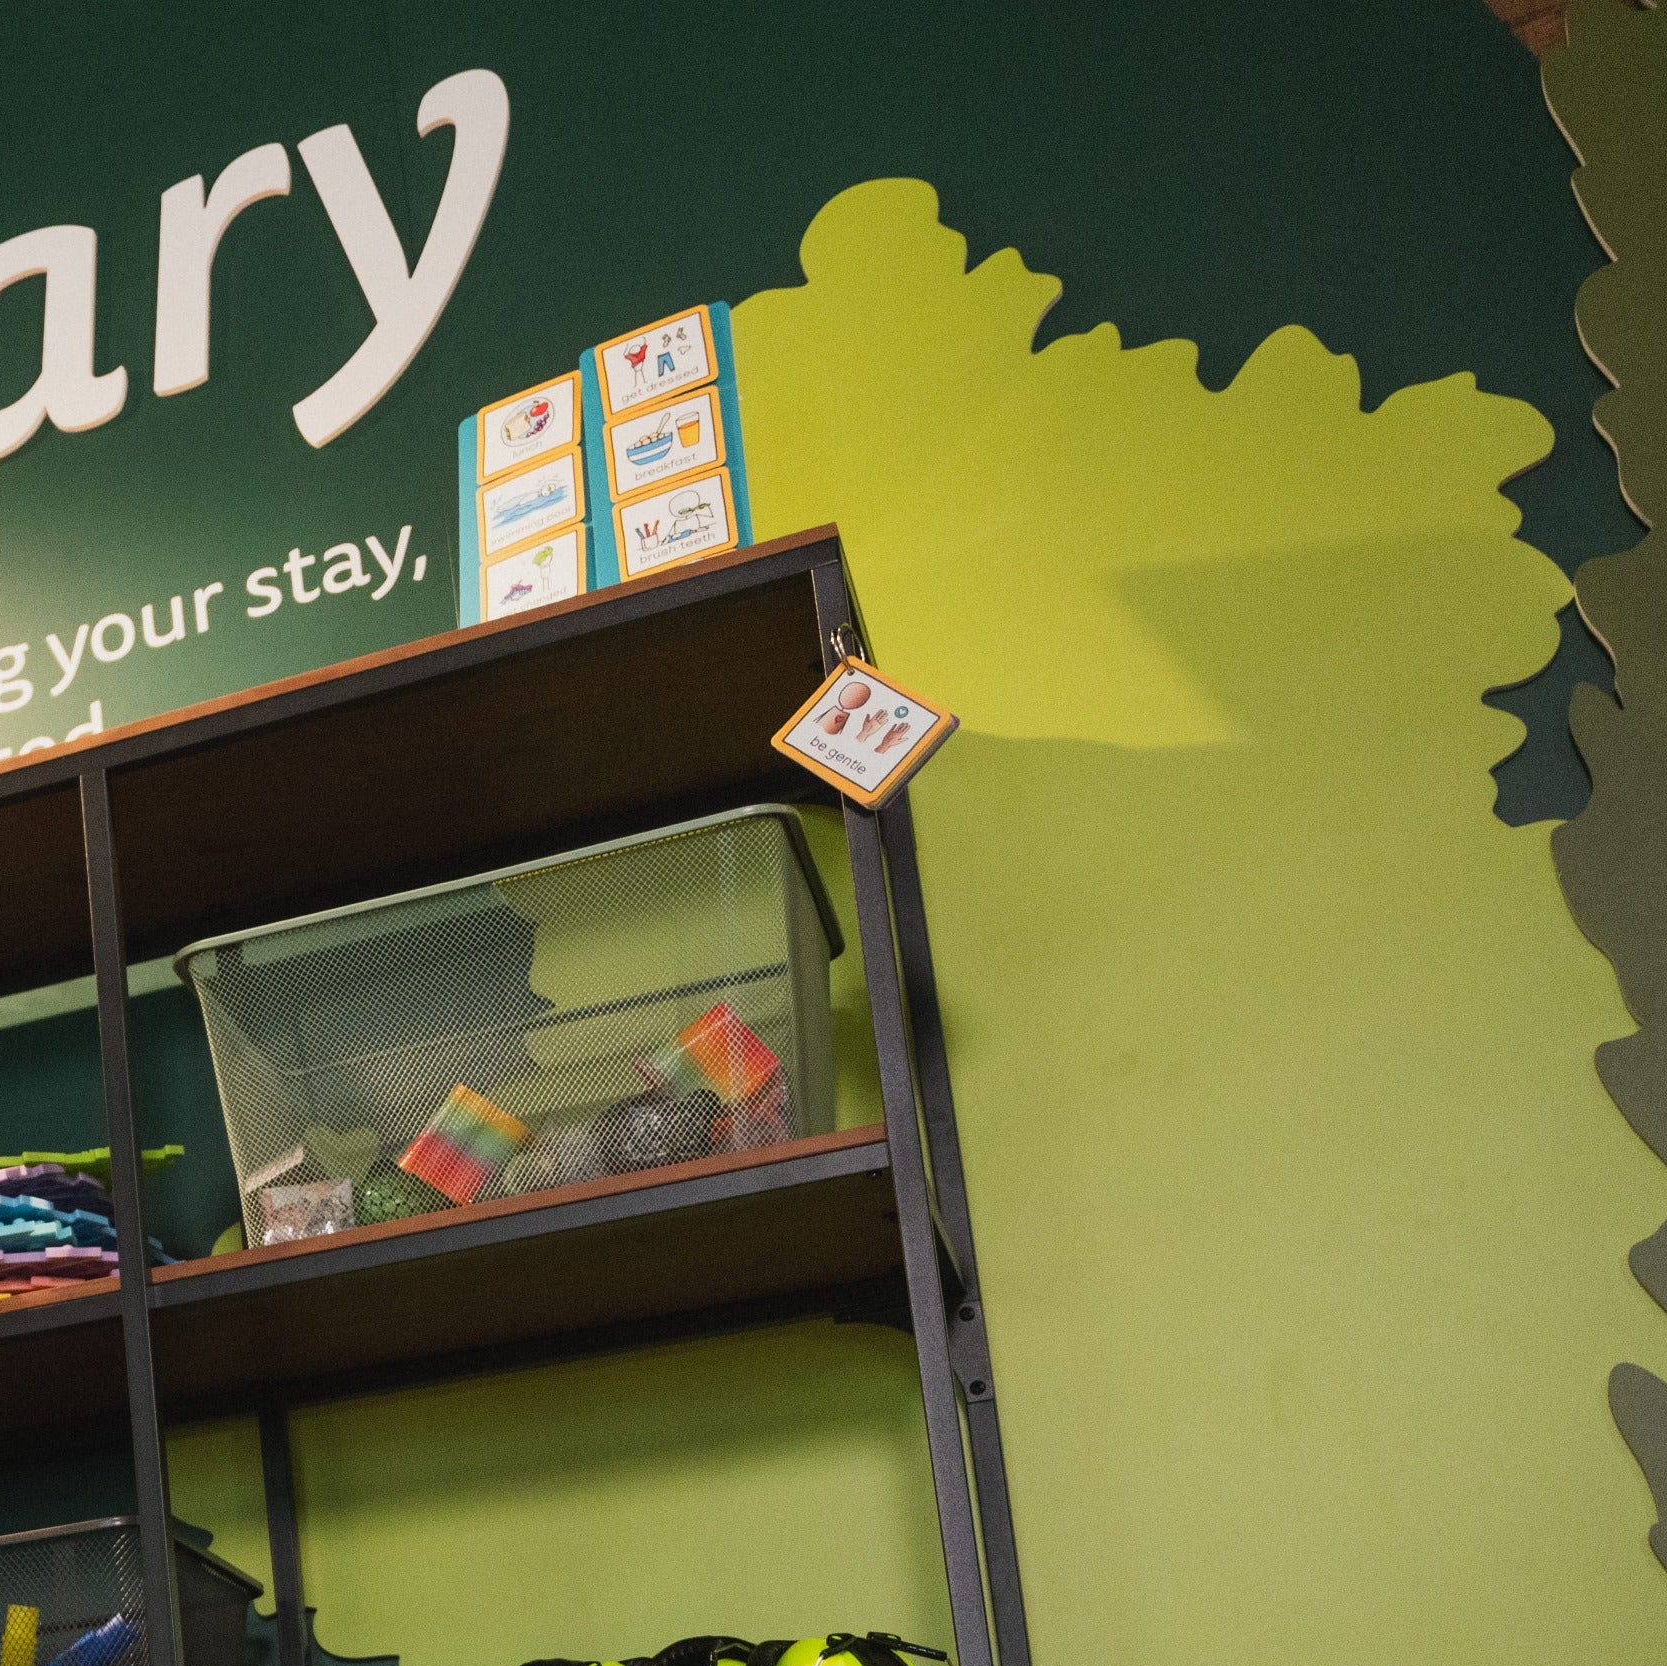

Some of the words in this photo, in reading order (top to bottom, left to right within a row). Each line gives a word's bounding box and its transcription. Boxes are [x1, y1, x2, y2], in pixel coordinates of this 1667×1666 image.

[621, 388, 644, 404] get
[646, 366, 699, 393] dressed
[512, 441, 543, 459] lunch
[634, 453, 697, 481] breakfast
[639, 544, 677, 565] brush
[680, 531, 716, 549] teeth
[46, 581, 224, 697] your
[246, 524, 427, 618] stay,
[810, 736, 827, 751] be
[825, 749, 867, 775] gentle
